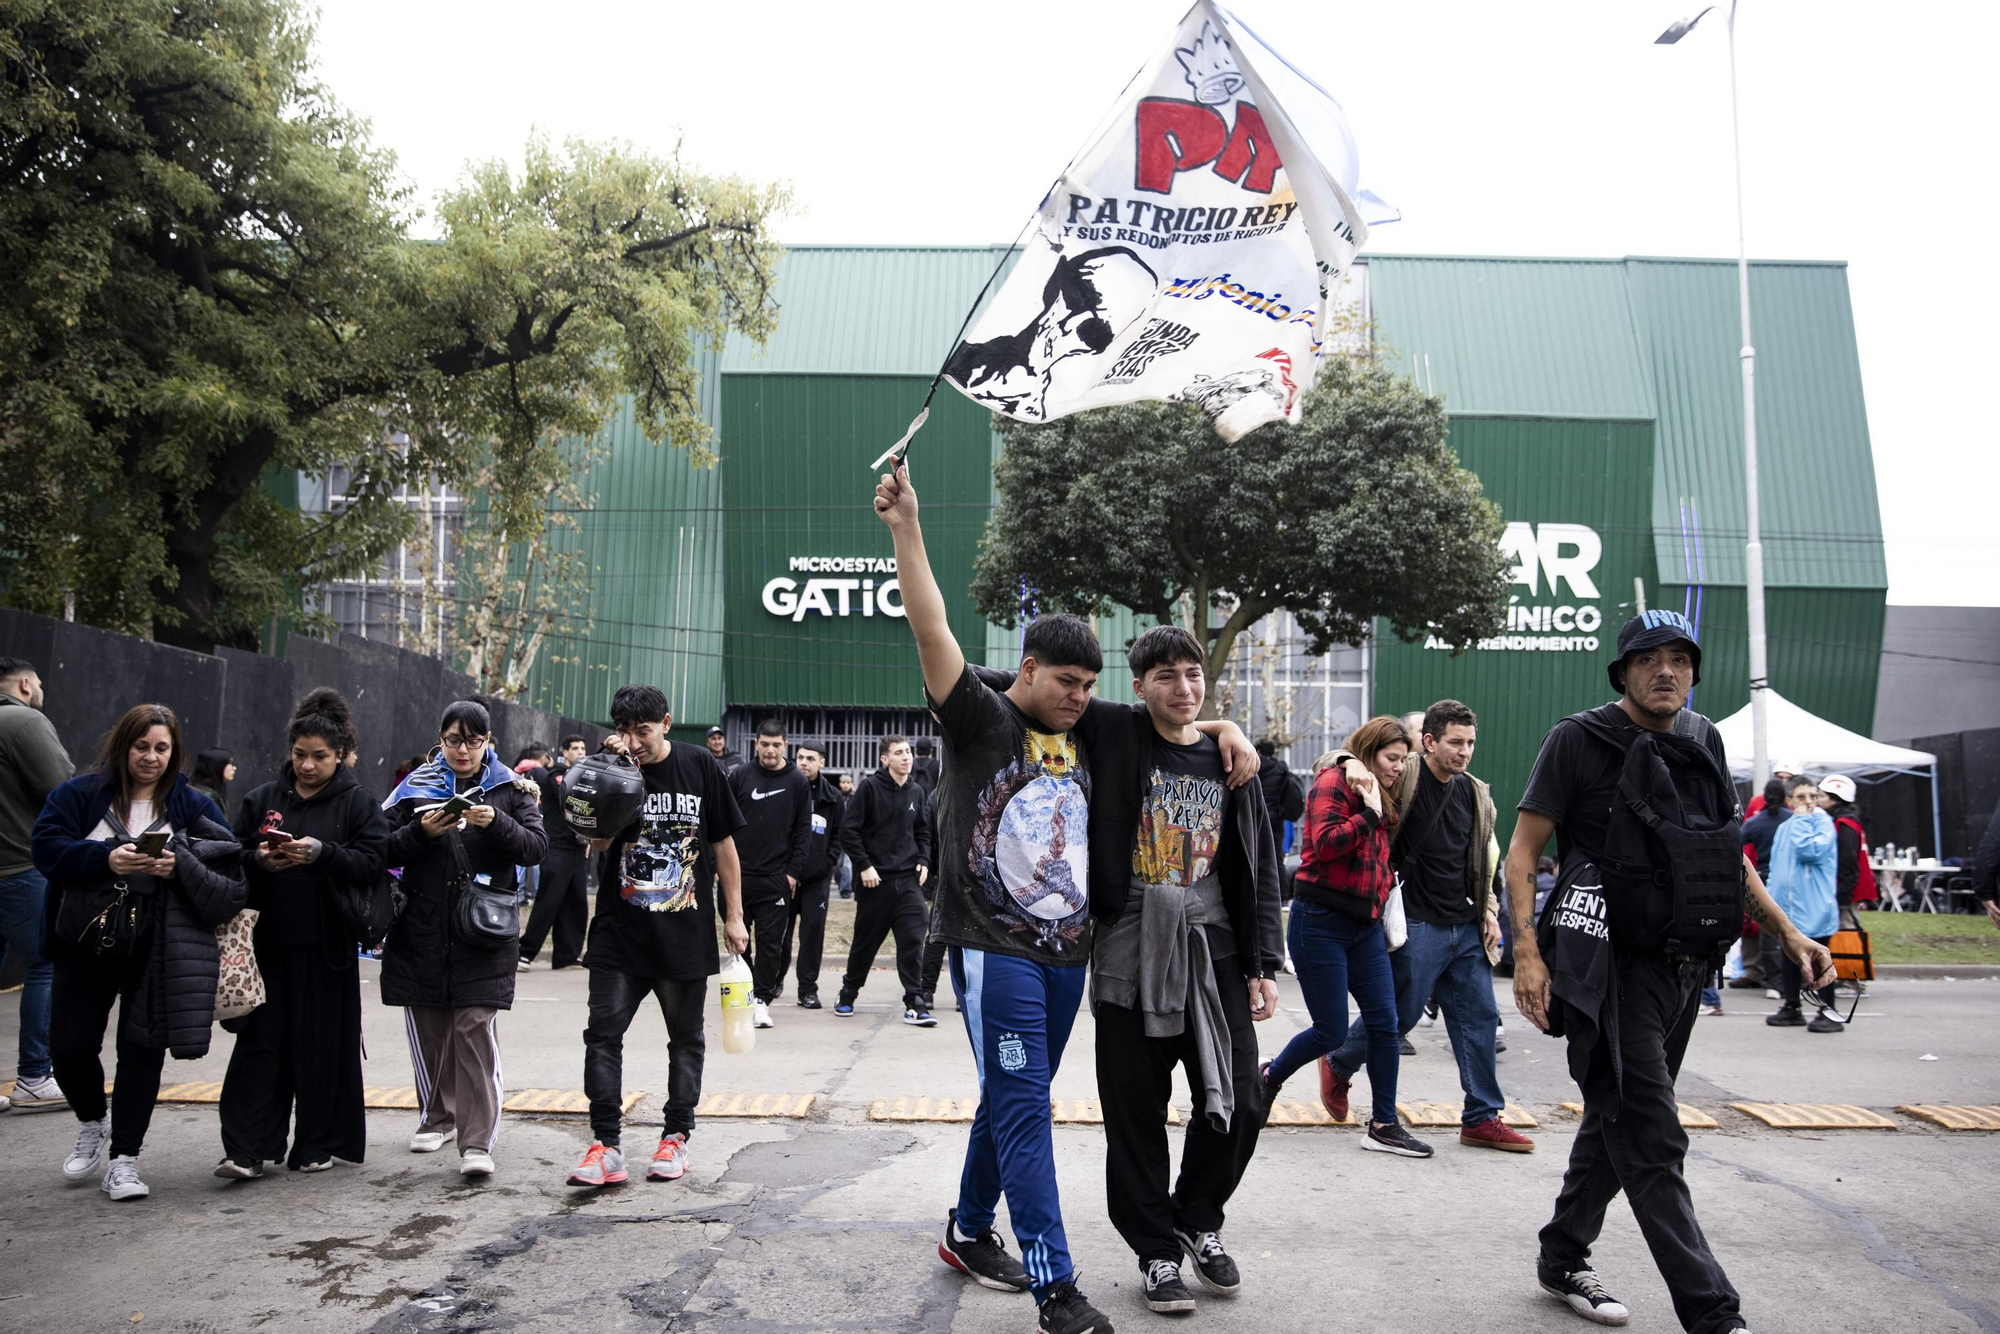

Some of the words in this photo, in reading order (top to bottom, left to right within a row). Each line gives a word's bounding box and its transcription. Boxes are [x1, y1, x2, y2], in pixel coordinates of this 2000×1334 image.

[1067, 194, 1237, 234] PATRICIO
[1239, 202, 1298, 228] REY
[1062, 226, 1072, 237] Y
[1077, 226, 1112, 241] SUS
[1213, 231, 1231, 243] DE
[1233, 222, 1287, 240] RICOTA
[1498, 522, 1602, 599] AR
[1477, 636, 1600, 651] RENDIMIENTO
[676, 793, 702, 816] REY
[1173, 804, 1205, 829] REY
